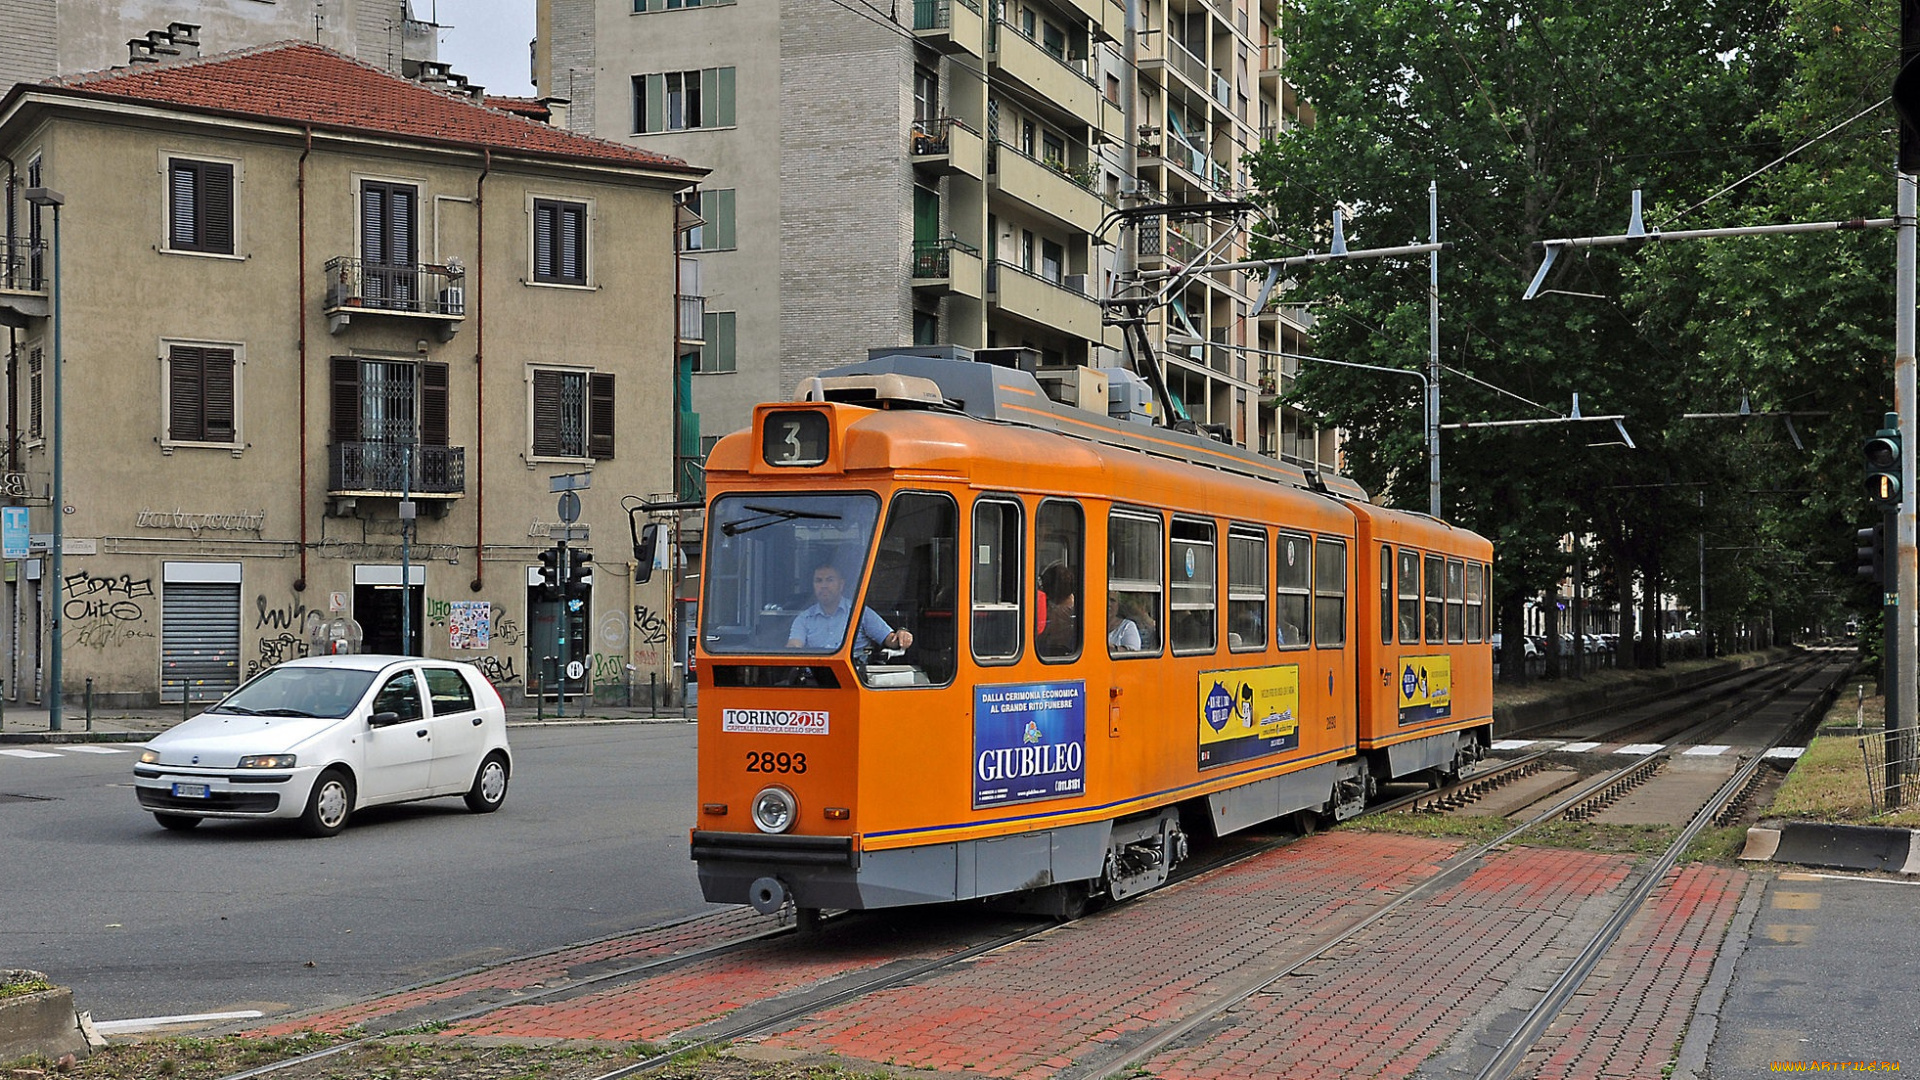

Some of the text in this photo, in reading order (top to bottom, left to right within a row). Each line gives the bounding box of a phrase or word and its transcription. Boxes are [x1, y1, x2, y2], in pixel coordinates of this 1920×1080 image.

[782, 421, 801, 461] 3
[982, 688, 1079, 703] DALLA CERIMONIA ECONOMICA
[990, 699, 1073, 714] AL GRANDE RITO FUNEBRE
[746, 751, 807, 774] 2893
[978, 741, 1082, 781] GIUBILEO
